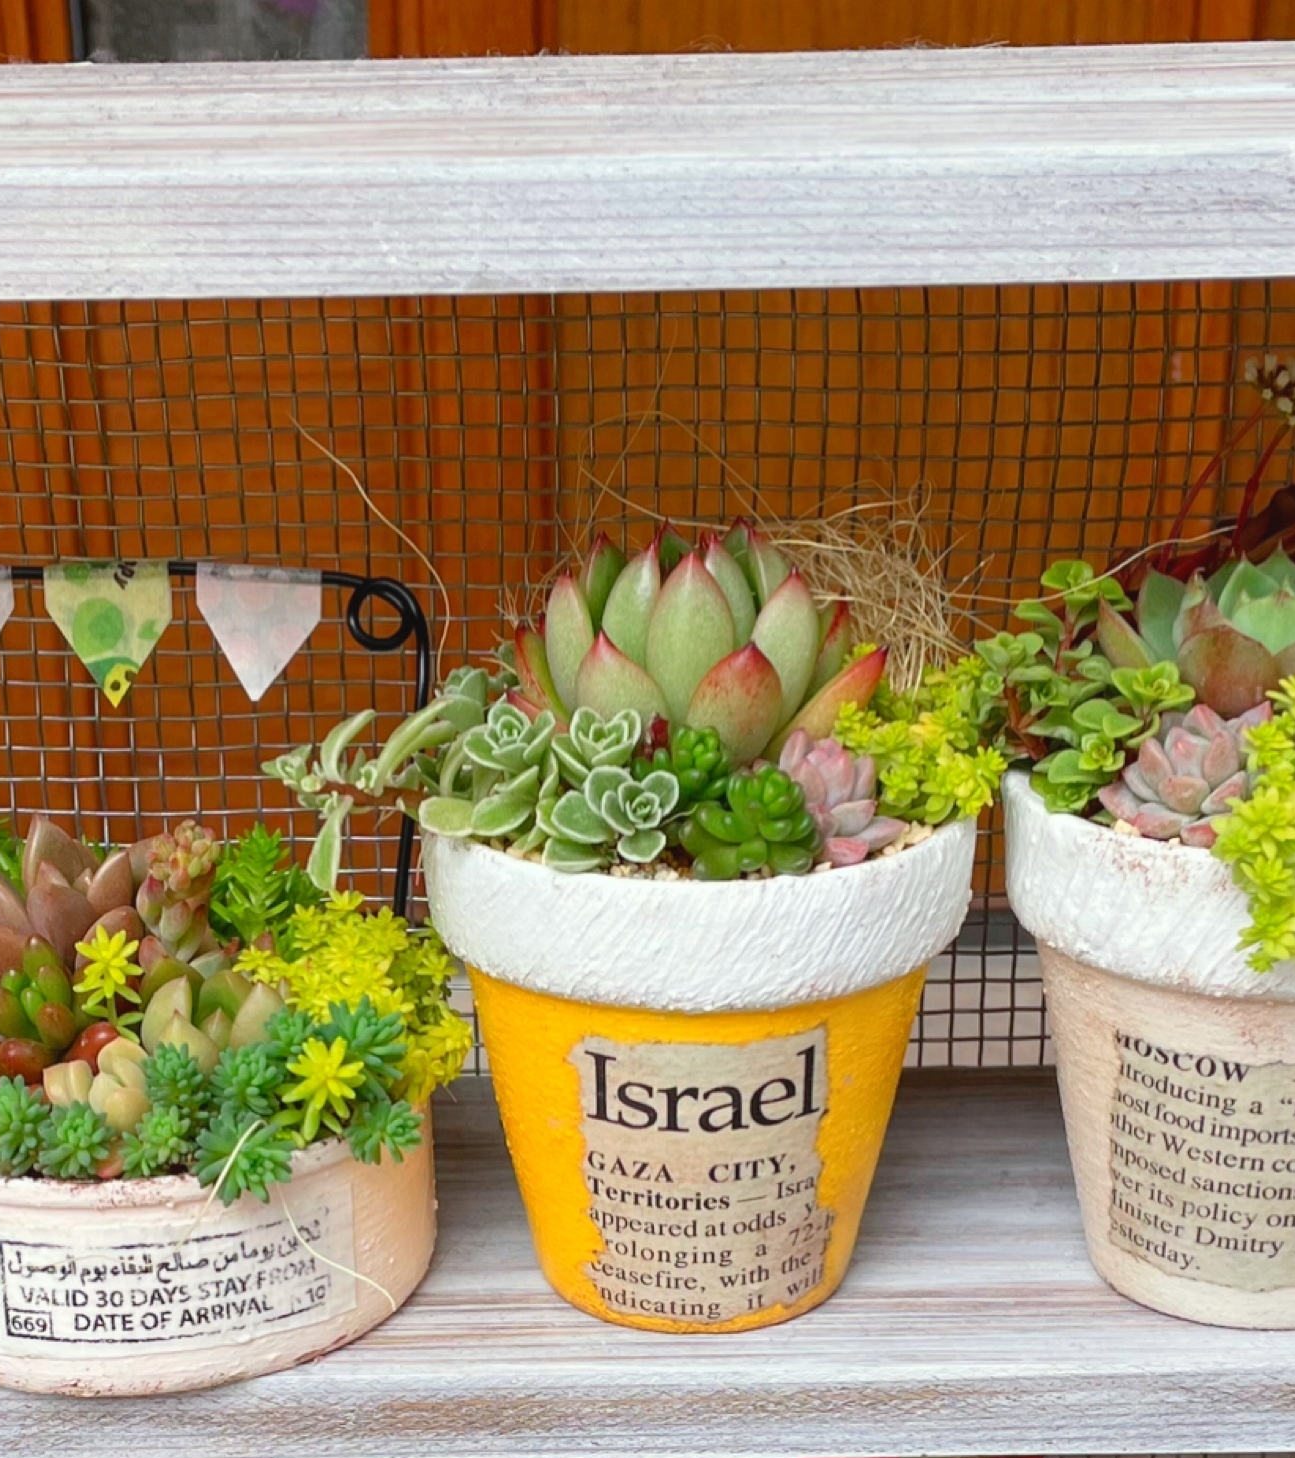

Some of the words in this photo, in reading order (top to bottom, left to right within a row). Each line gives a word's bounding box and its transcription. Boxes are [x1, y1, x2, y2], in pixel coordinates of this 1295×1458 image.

[584, 1044, 820, 1132] Israel
[1155, 1103, 1205, 1134] food
[1249, 1100, 1263, 1115] a
[588, 1151, 674, 1183] GAZA
[708, 1153, 796, 1183] CITY,
[1162, 1131, 1264, 1172] Western
[588, 1175, 730, 1211] Territories
[1149, 1183, 1174, 1208] its
[1182, 1200, 1257, 1230] policy
[589, 1207, 697, 1237] appeared
[705, 1224, 726, 1237] at
[733, 1210, 787, 1235] odds
[755, 1244, 767, 1255] a
[1195, 1226, 1284, 1258] Dmitry
[20, 1285, 89, 1307] VALID
[95, 1290, 124, 1307] 30
[131, 1285, 191, 1307] DAYS
[198, 1273, 252, 1300] STAY
[256, 1257, 316, 1289] FROM
[720, 1266, 770, 1288] with
[781, 1252, 811, 1274] the
[11, 1315, 47, 1332] 669
[74, 1312, 135, 1332] DATE
[141, 1311, 172, 1330] OF
[179, 1294, 274, 1328] ARRIVAL
[747, 1293, 765, 1310] it
